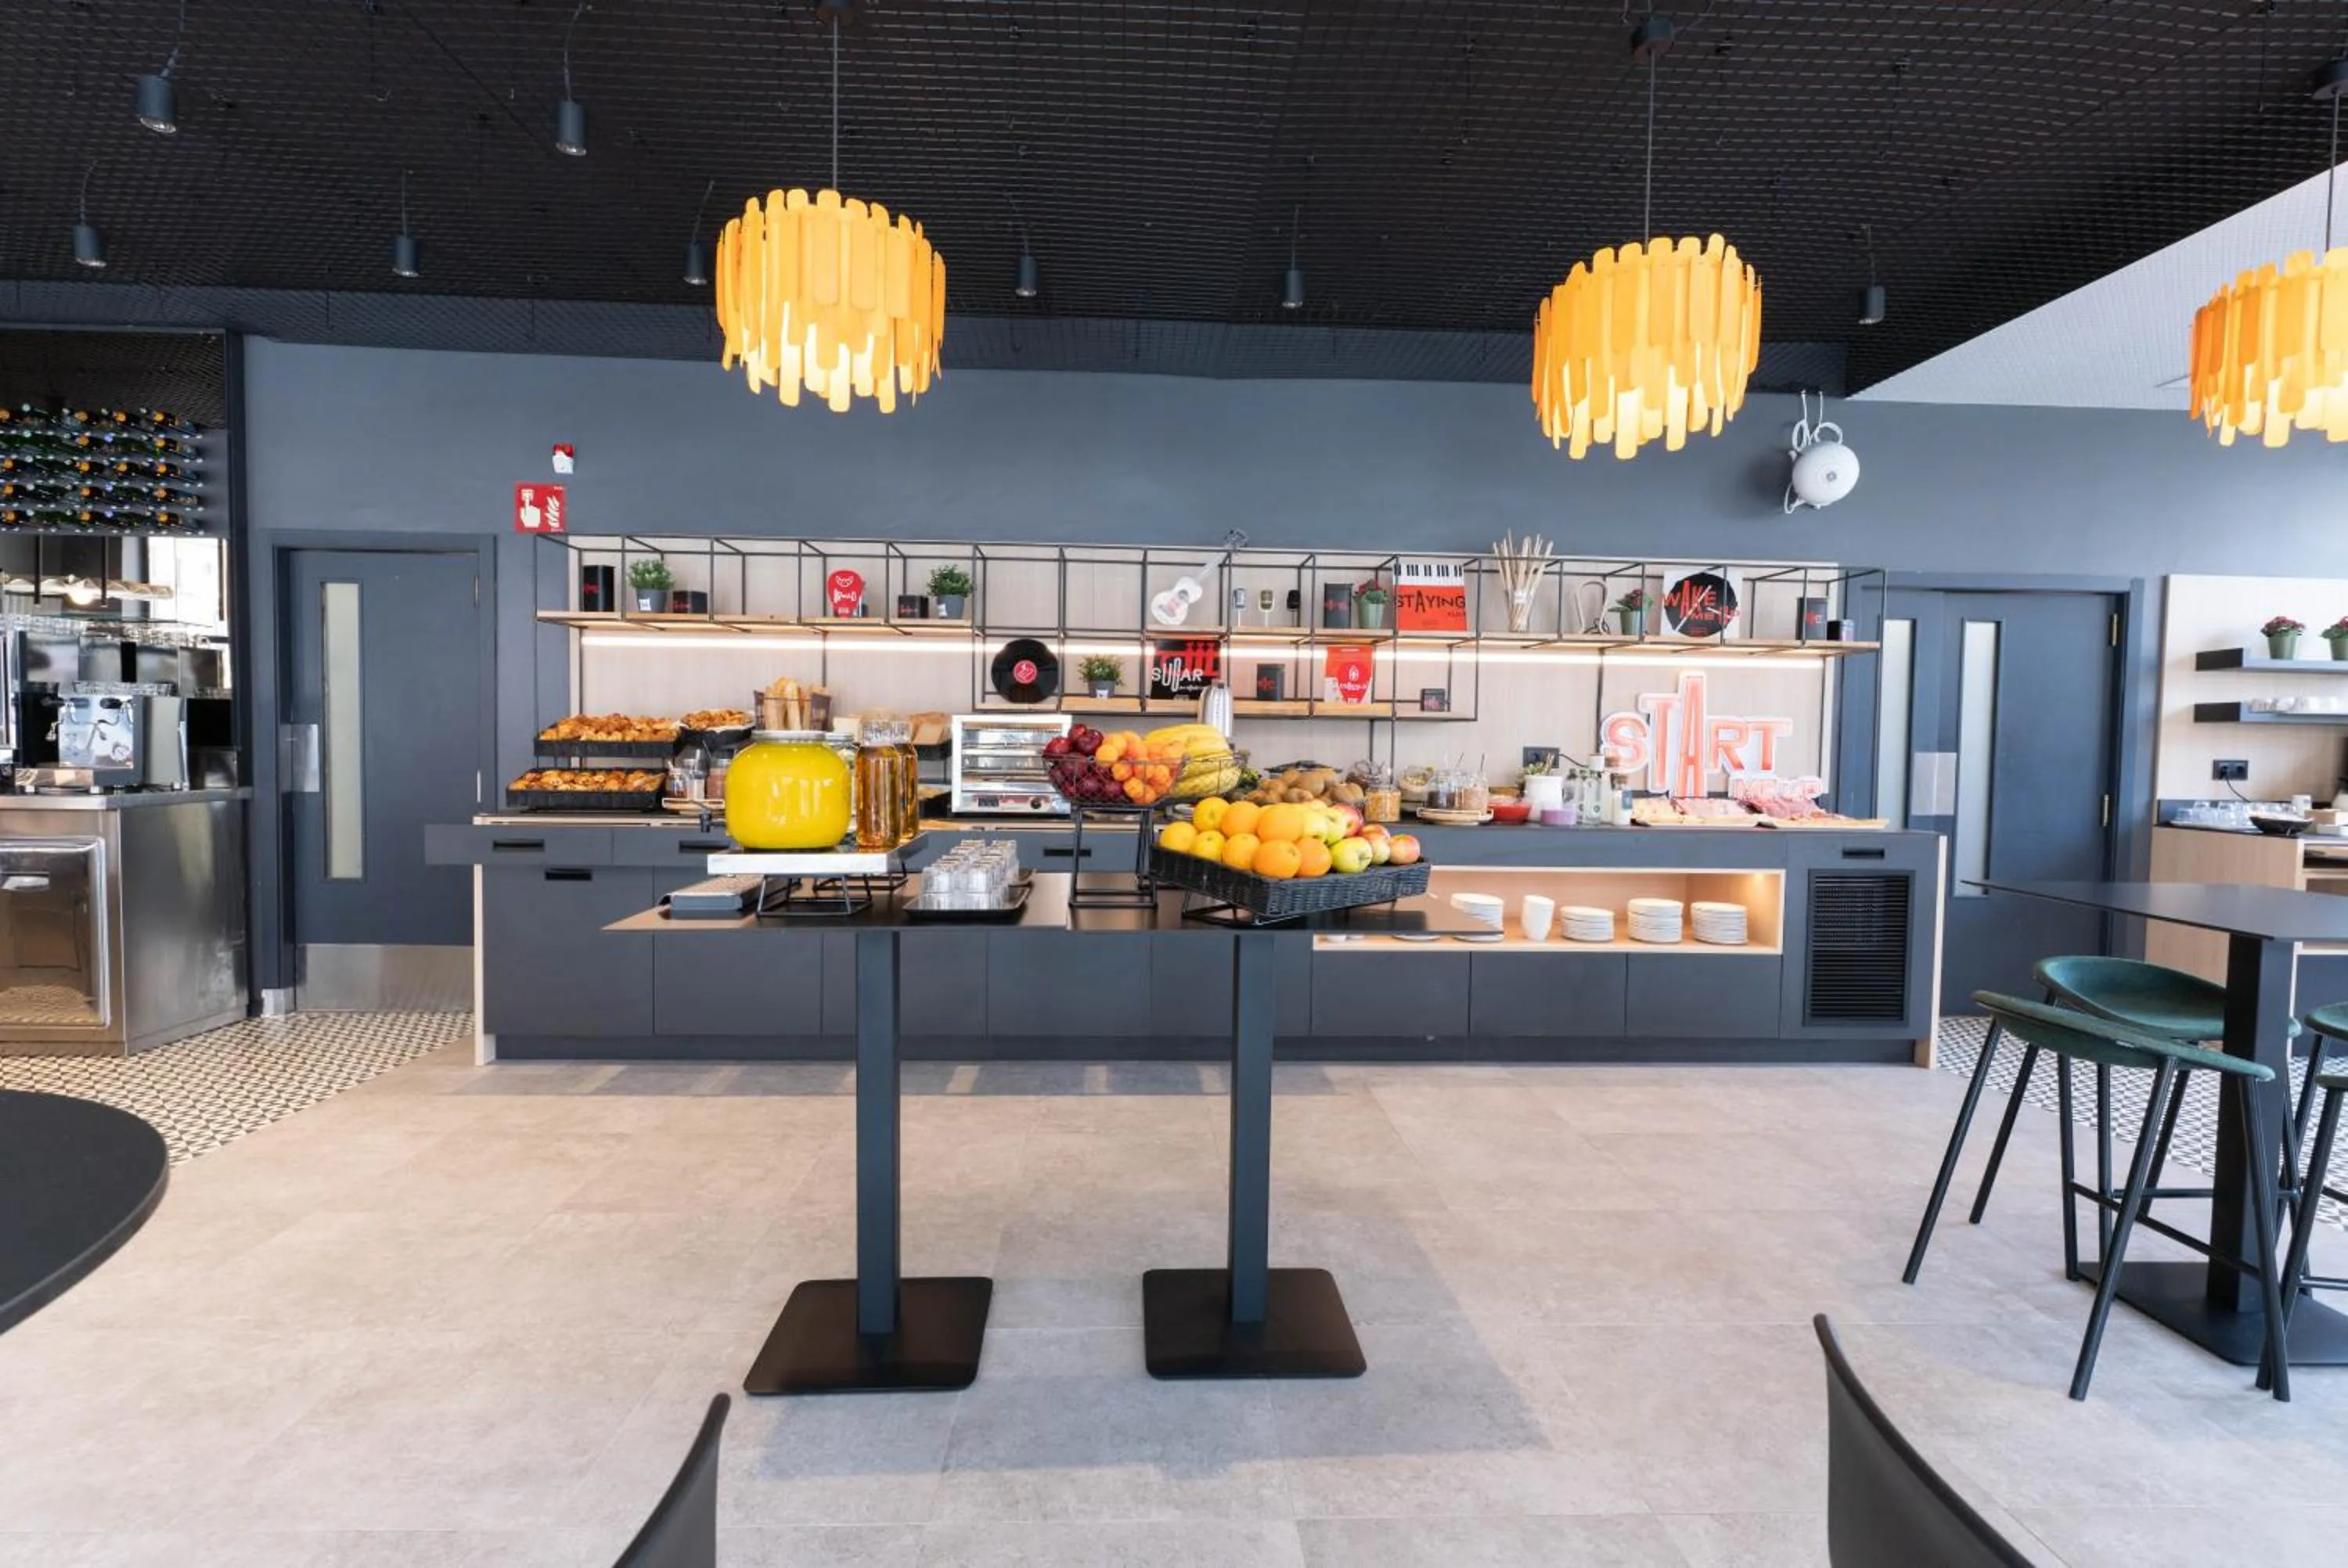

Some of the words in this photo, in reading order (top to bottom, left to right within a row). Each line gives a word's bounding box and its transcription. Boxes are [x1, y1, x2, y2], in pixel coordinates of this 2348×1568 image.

[1397, 589, 1465, 613] STAYING
[1662, 580, 1716, 620] WAKE
[1601, 673, 1791, 797] START
